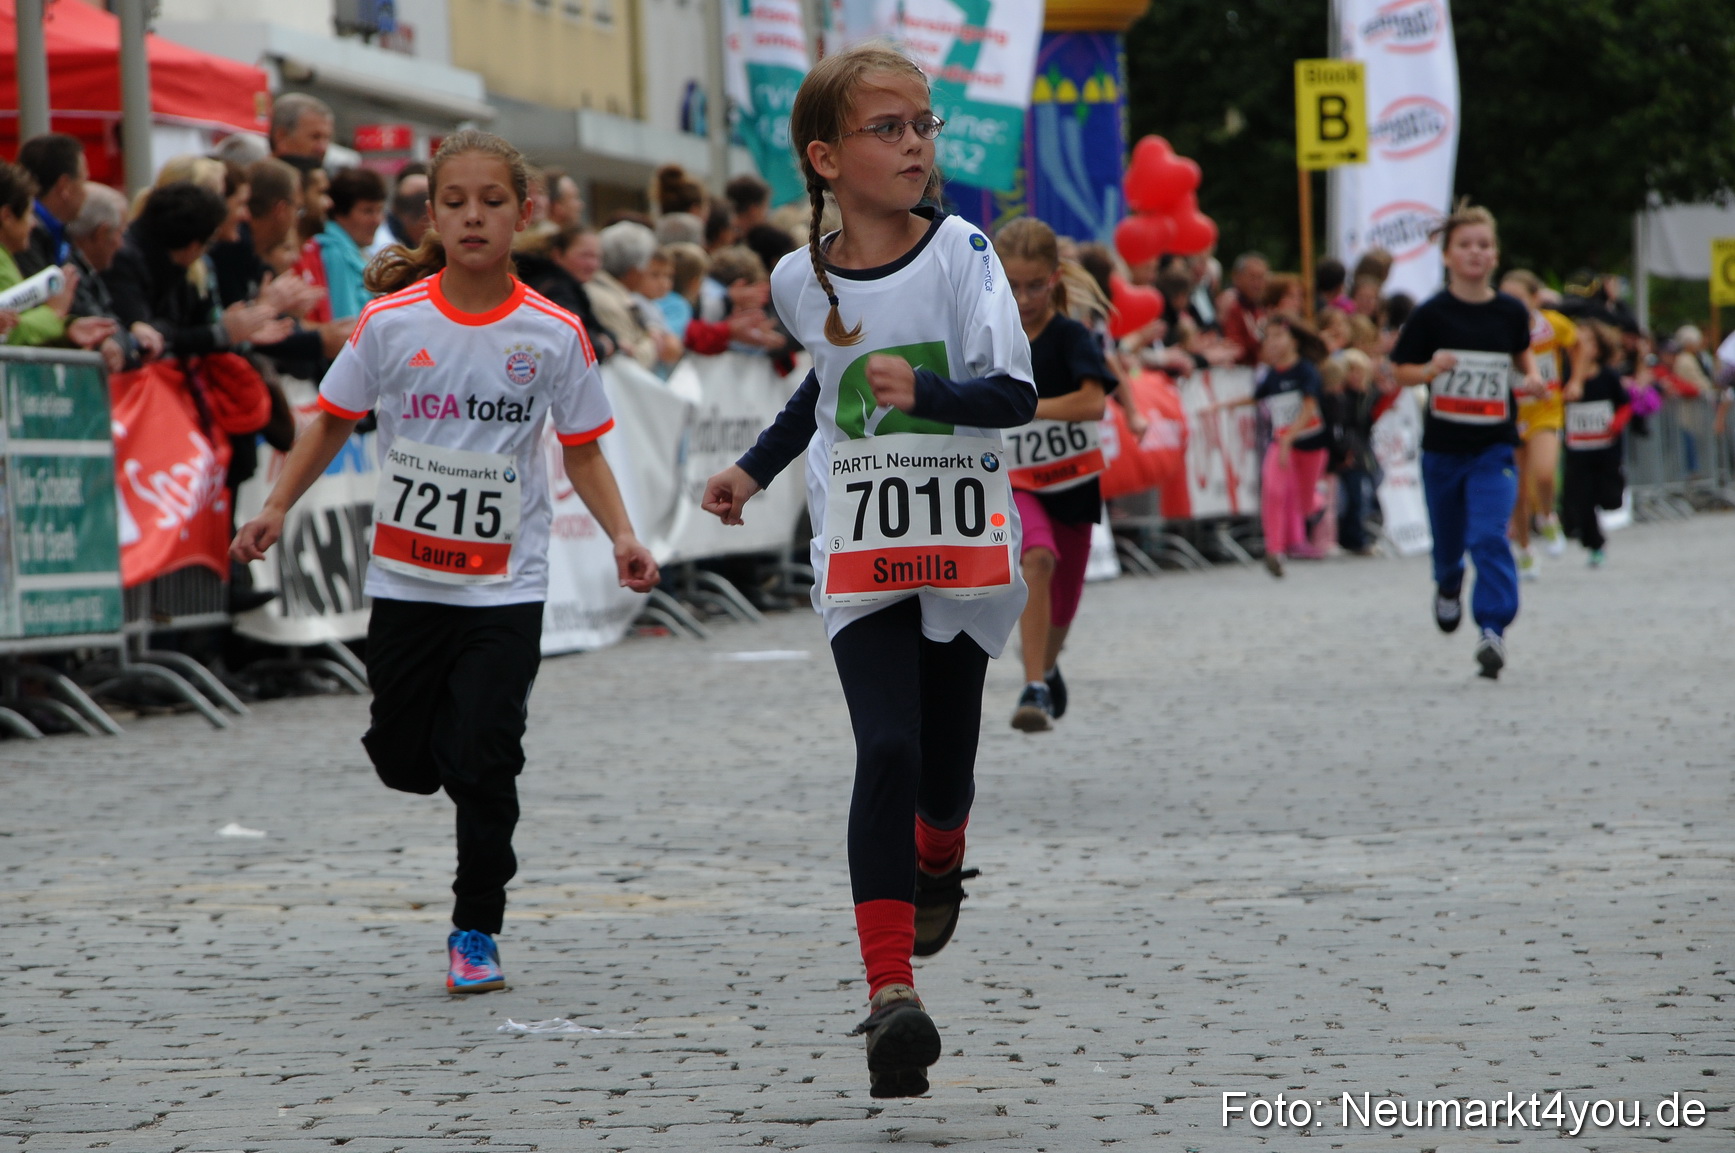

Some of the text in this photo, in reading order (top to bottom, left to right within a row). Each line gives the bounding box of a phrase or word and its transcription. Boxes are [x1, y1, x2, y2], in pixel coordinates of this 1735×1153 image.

[1318, 95, 1349, 141] B
[1444, 369, 1499, 397] 7275
[1008, 422, 1088, 465] 7266
[388, 449, 497, 480] PARTL Neumarkt
[832, 454, 882, 475] PARTL
[887, 452, 973, 469] Neumarkt
[393, 474, 502, 539] 7215
[846, 476, 986, 542] 7010
[834, 539, 840, 549] 5
[992, 532, 1003, 541] W
[411, 539, 466, 568] Laura
[873, 554, 958, 584] Smilla
